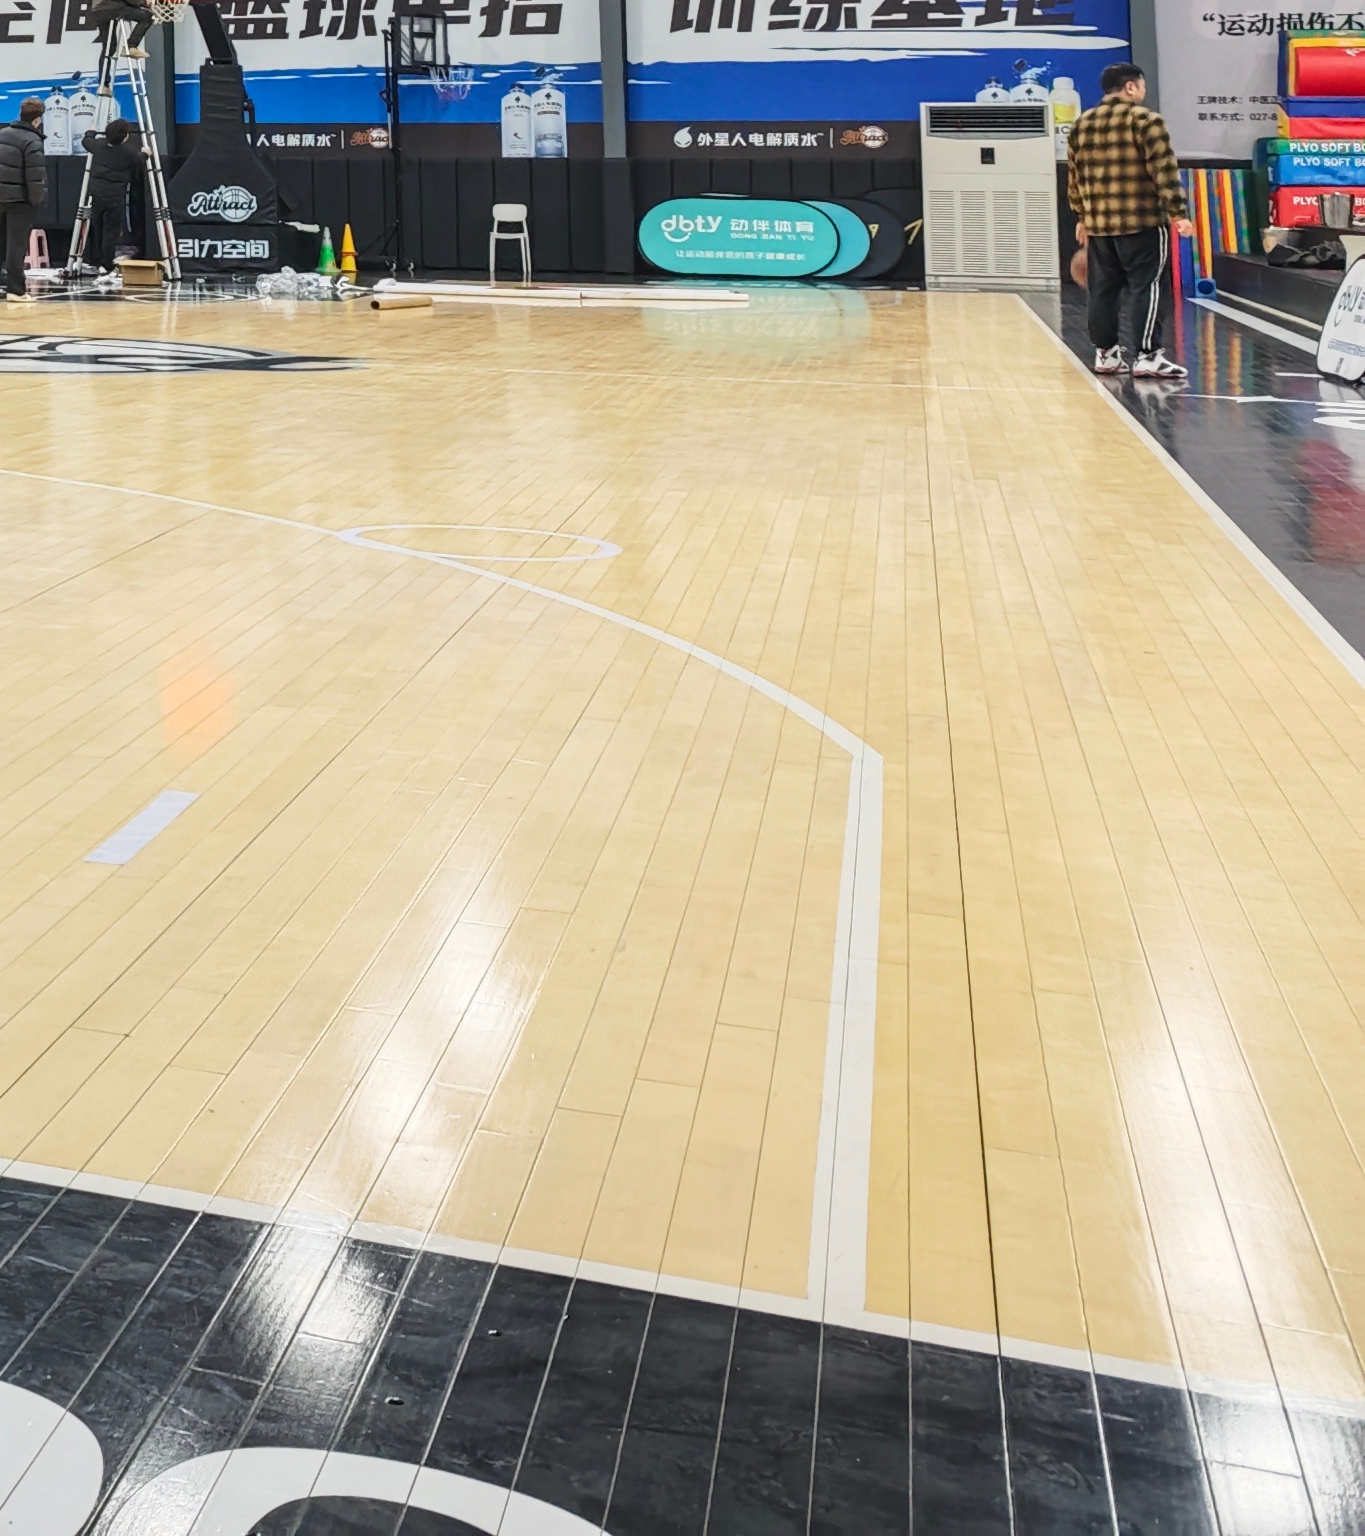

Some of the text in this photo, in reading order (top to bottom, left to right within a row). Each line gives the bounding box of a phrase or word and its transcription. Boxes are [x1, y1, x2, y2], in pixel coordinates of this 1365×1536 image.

[697, 133, 818, 147] 外星人电解质水
[1289, 142, 1319, 153] PLYO
[1321, 141, 1351, 153] SOFT
[1293, 156, 1321, 167] PLYO
[1324, 156, 1351, 167] SOFT
[178, 238, 269, 259] 引力空间
